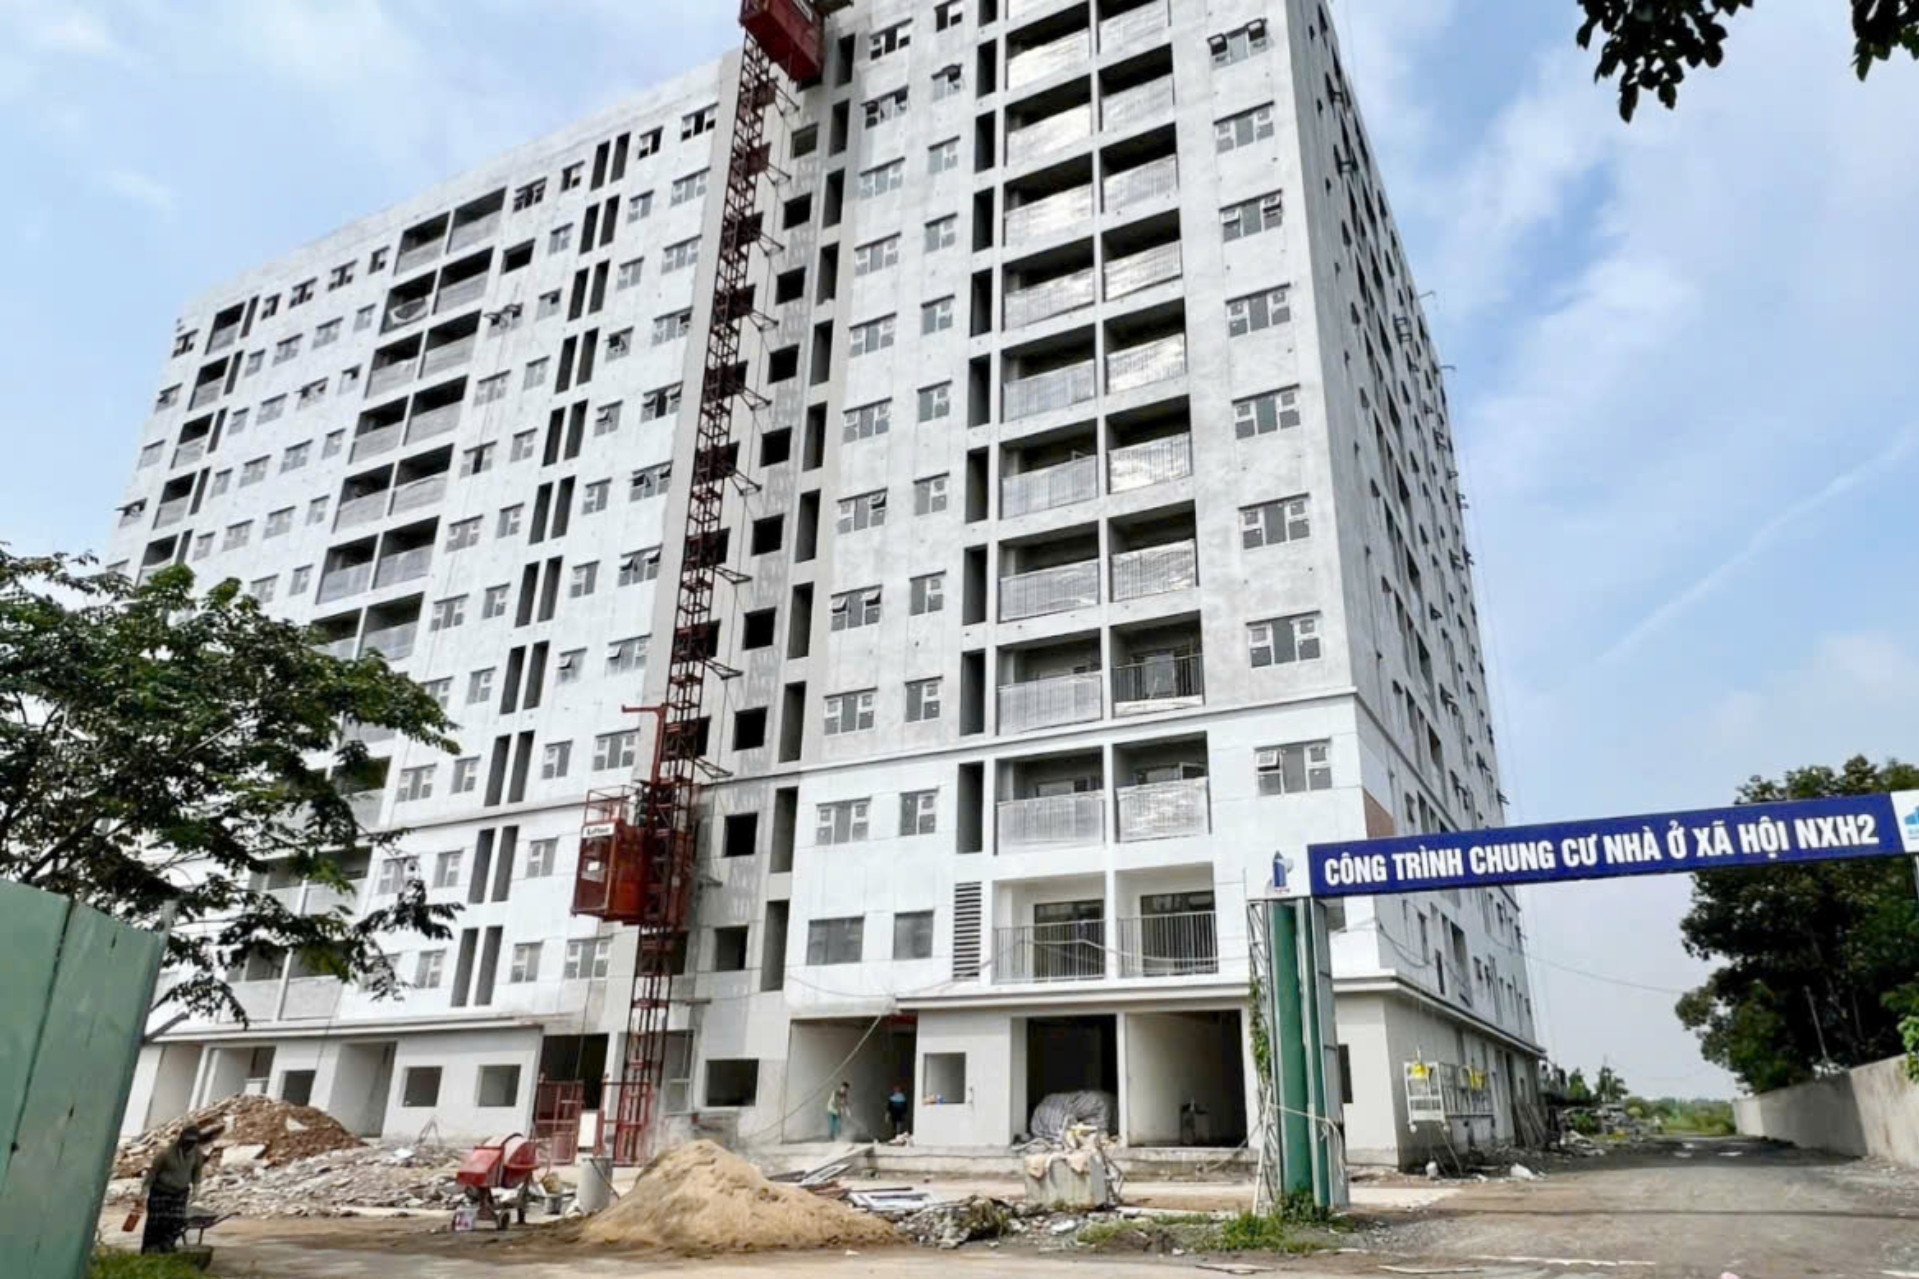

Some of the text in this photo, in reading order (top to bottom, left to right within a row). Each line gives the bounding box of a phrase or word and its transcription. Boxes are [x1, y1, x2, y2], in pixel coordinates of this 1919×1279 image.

[1324, 813, 1880, 886] CÔNG TRÌNH CHUNG CƯ NHÀ Ở XÃ HỘI NXH2
